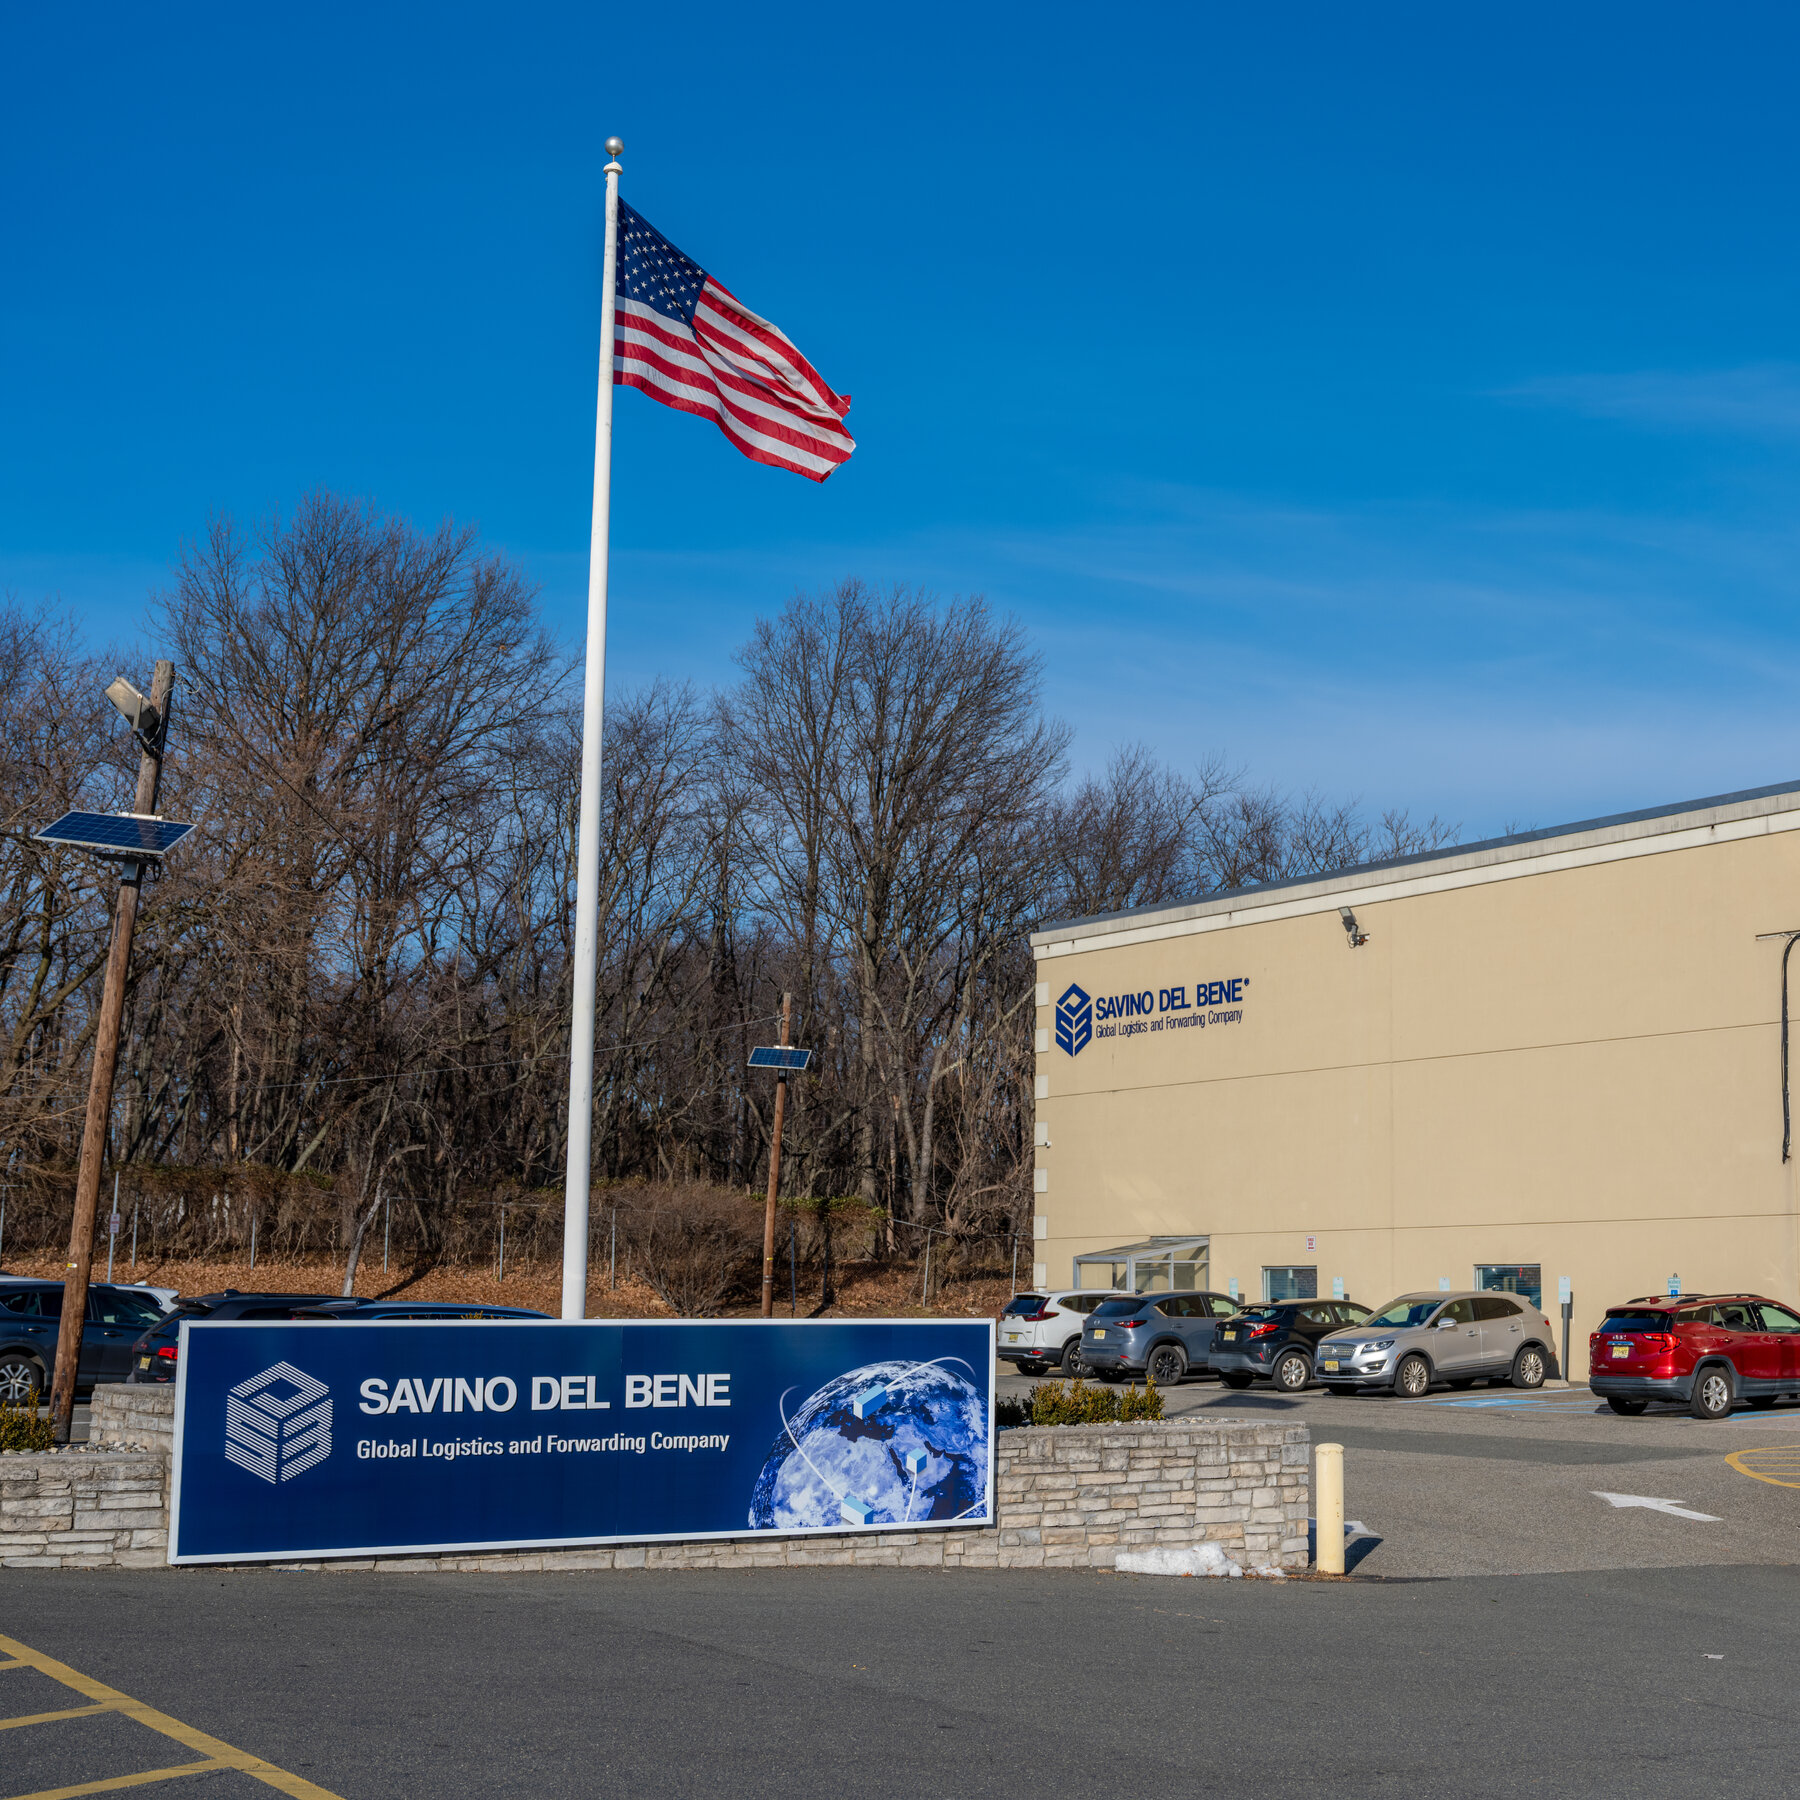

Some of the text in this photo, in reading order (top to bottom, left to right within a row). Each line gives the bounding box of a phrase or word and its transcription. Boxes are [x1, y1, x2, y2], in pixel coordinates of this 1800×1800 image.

[1096, 991, 1154, 1020] SAVINO
[1159, 987, 1191, 1011] DEL
[1096, 1009, 1243, 1038] Global Logistics and Forwarding Company
[359, 1373, 731, 1415] SAVINO DEL BENE
[357, 1432, 730, 1460] Global Logistics and Forwarding Company
